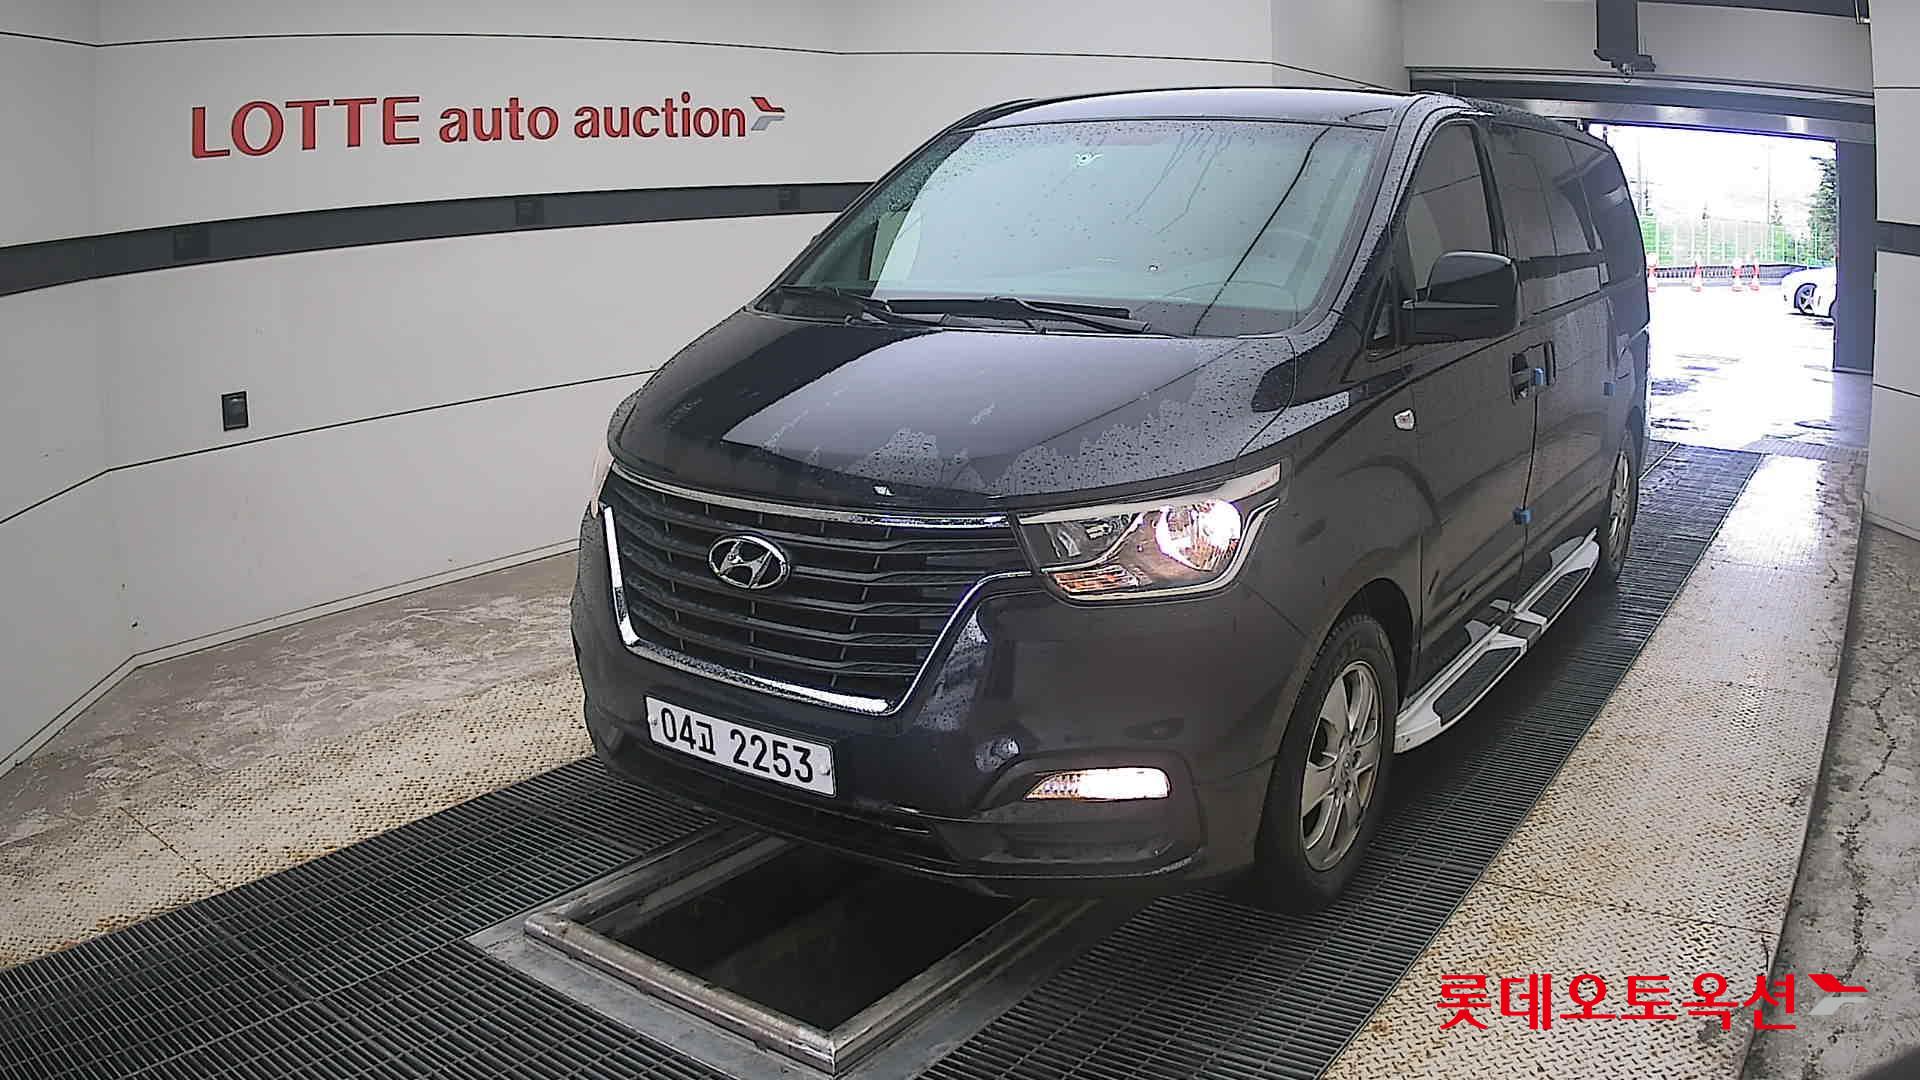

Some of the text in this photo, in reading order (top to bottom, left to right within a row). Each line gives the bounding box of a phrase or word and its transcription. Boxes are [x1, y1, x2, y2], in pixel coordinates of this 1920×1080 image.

[192, 92, 746, 159] LOTTE auto auction
[660, 707, 814, 783] 04고 2253
